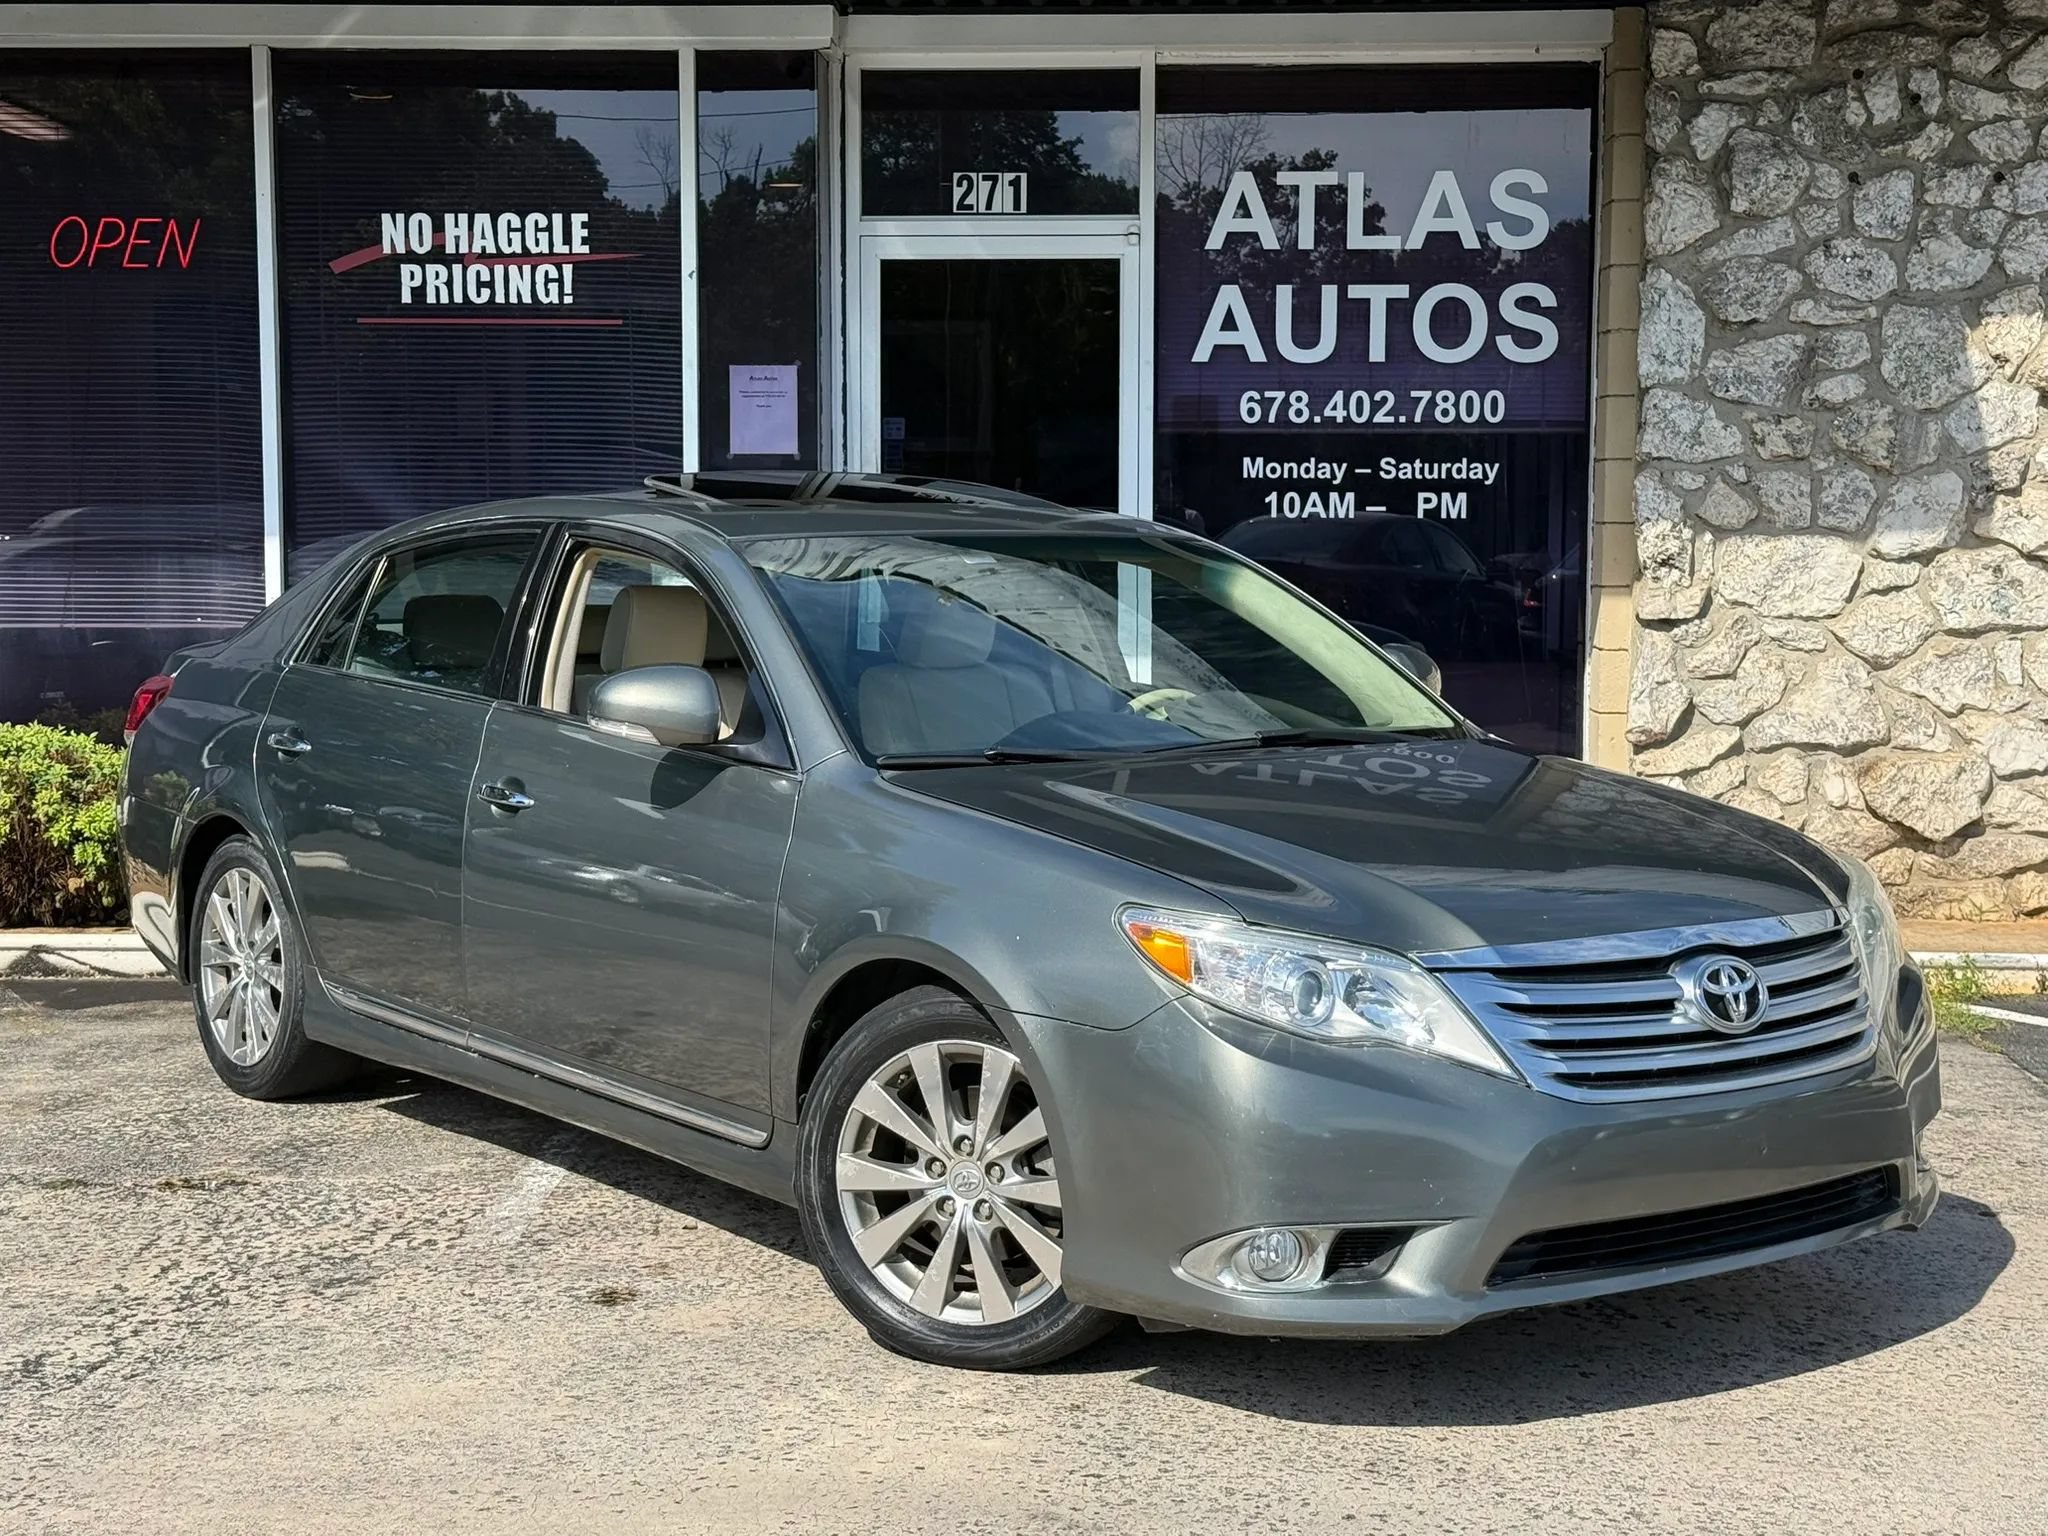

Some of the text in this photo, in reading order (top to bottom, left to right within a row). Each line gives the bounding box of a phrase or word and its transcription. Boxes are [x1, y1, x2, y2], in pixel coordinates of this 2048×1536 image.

[955, 173, 1022, 212] 271
[1204, 168, 1550, 251] ATLAS
[51, 216, 201, 268] OPEN
[381, 212, 590, 255] NO HAGGLE
[400, 263, 574, 304] PRICING!
[1191, 282, 1560, 364] AUTOS
[1239, 389, 1506, 424] 678.402.7800
[1242, 456, 1348, 485] Monday
[1379, 456, 1500, 485] Saturday
[1264, 491, 1355, 519] 10AM
[1417, 492, 1467, 519] PM
